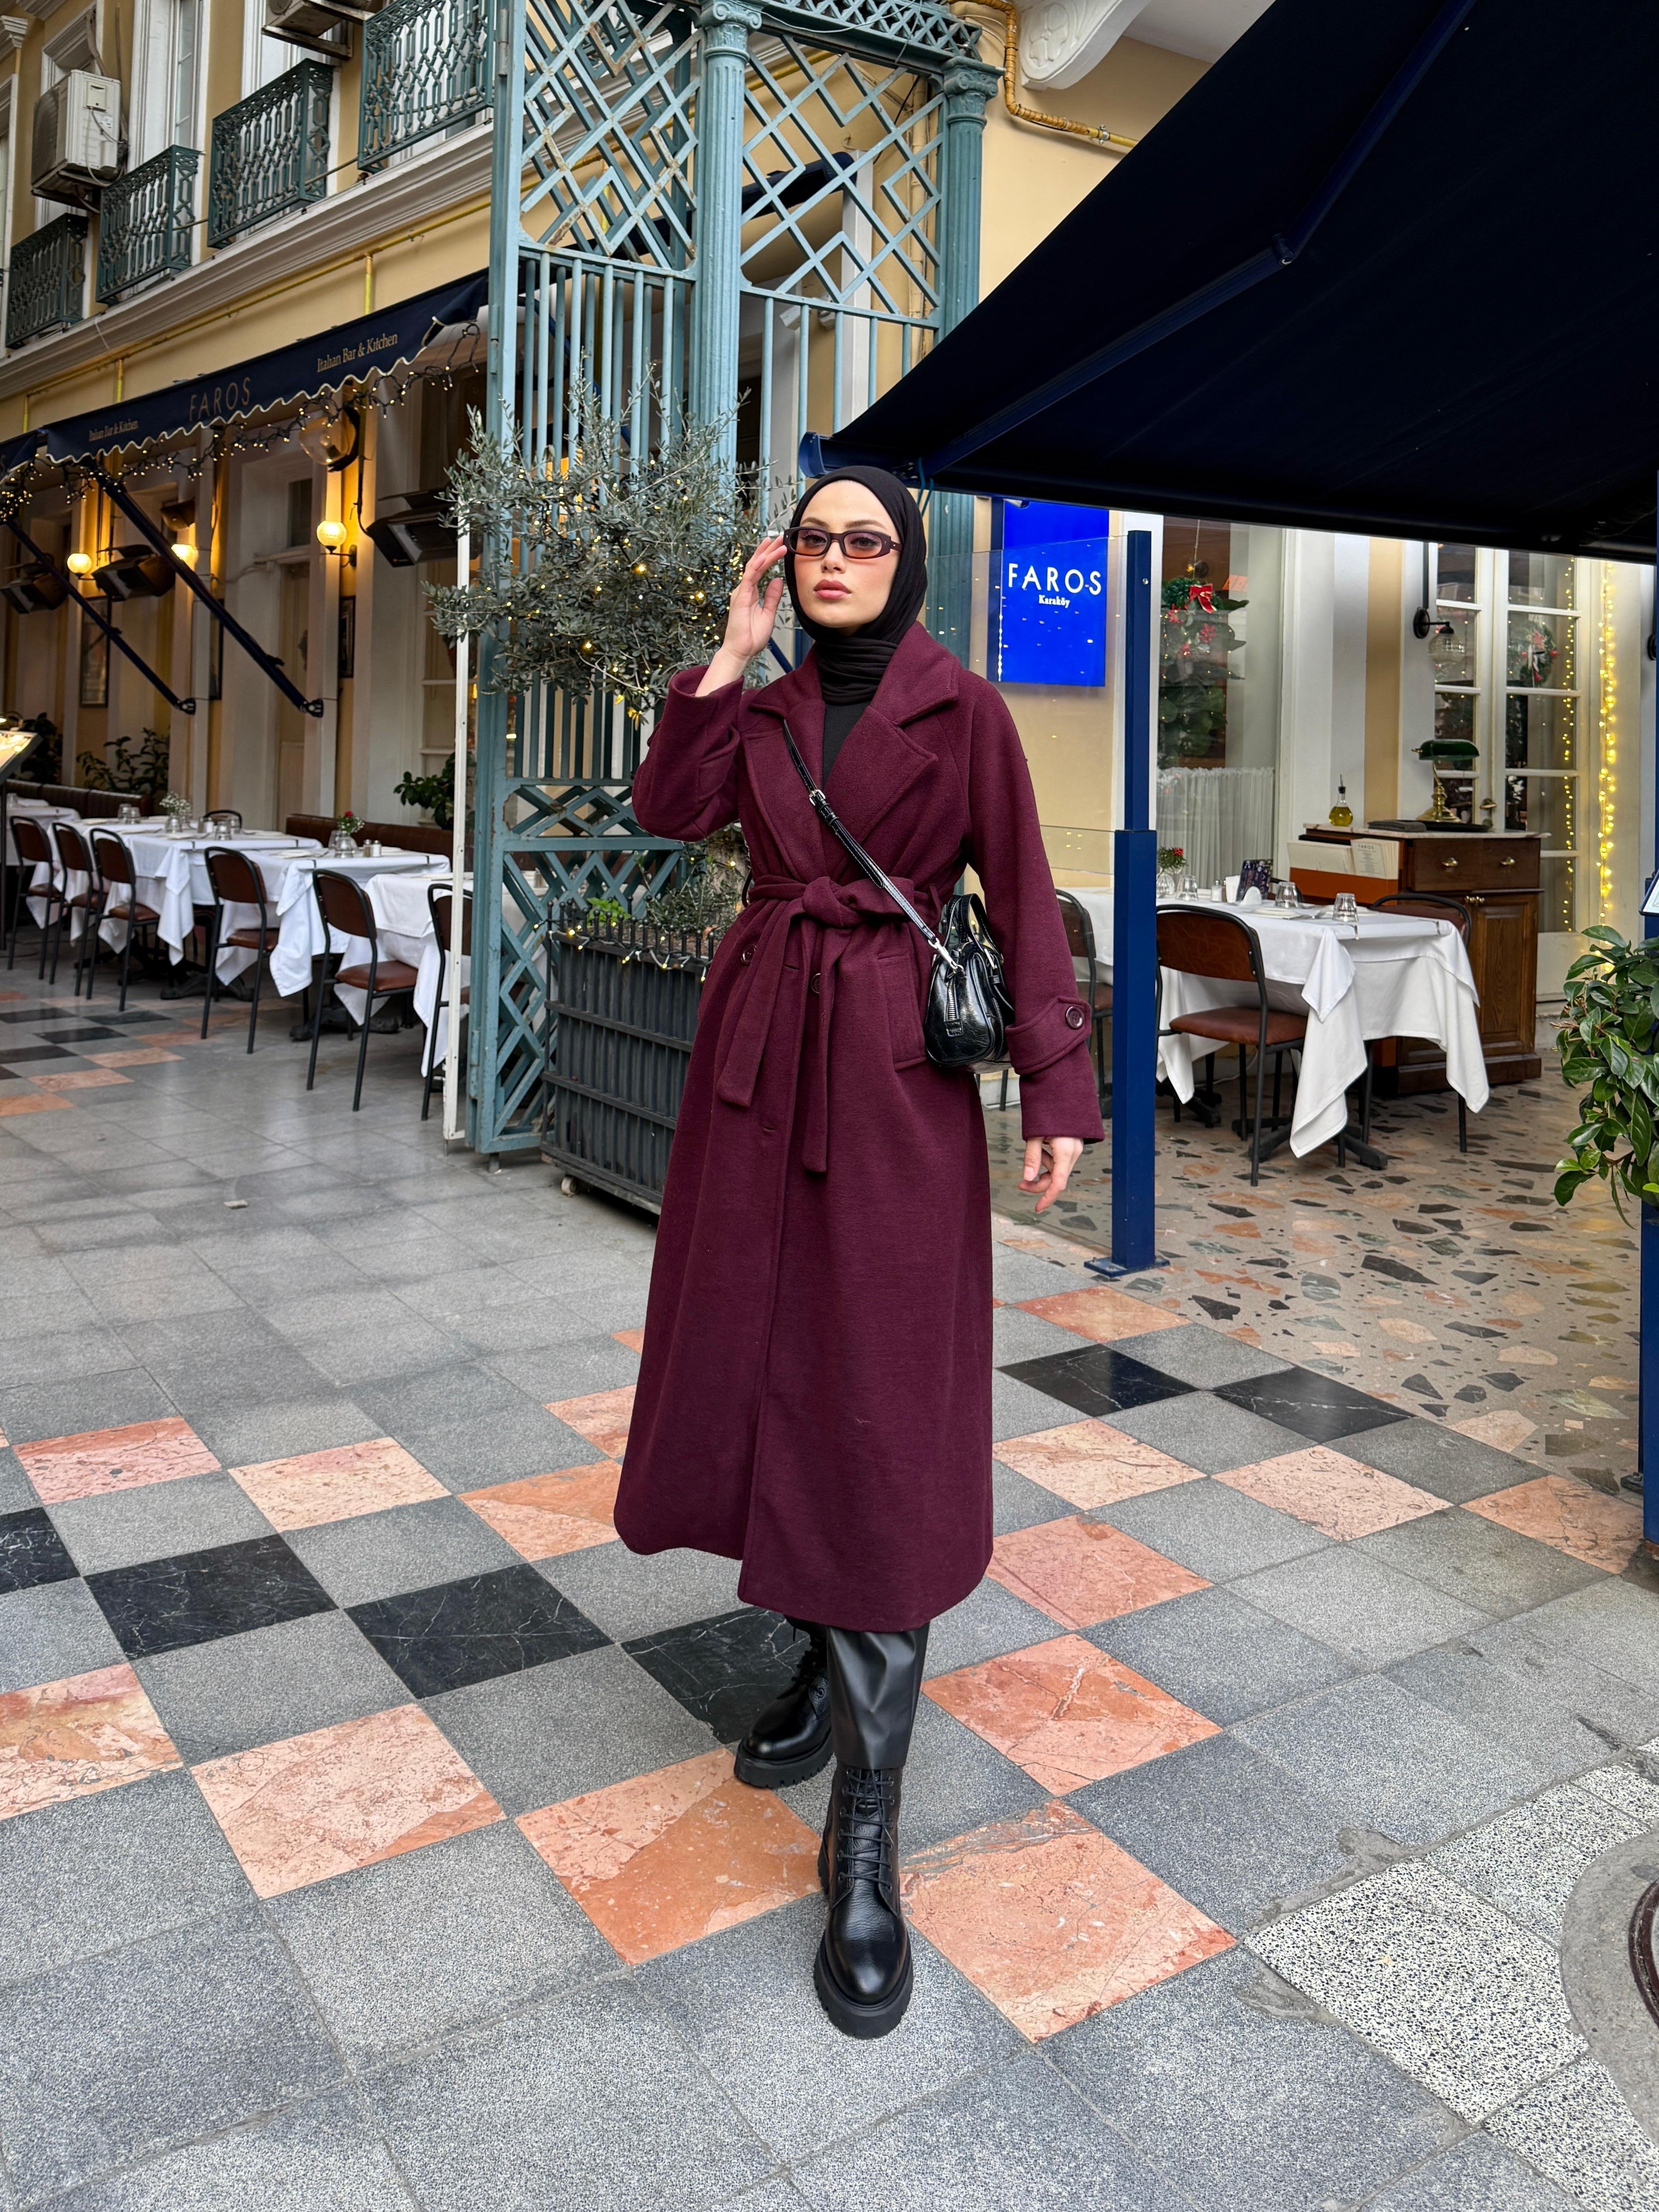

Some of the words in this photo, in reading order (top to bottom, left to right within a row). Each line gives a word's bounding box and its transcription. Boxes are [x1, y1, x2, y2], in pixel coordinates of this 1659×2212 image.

[343, 348, 356, 363] Bar
[358, 343, 365, 357] &
[189, 377, 250, 421] FAROS
[1008, 563, 1101, 595] FAROS
[1038, 595, 1070, 608] Karaköy
